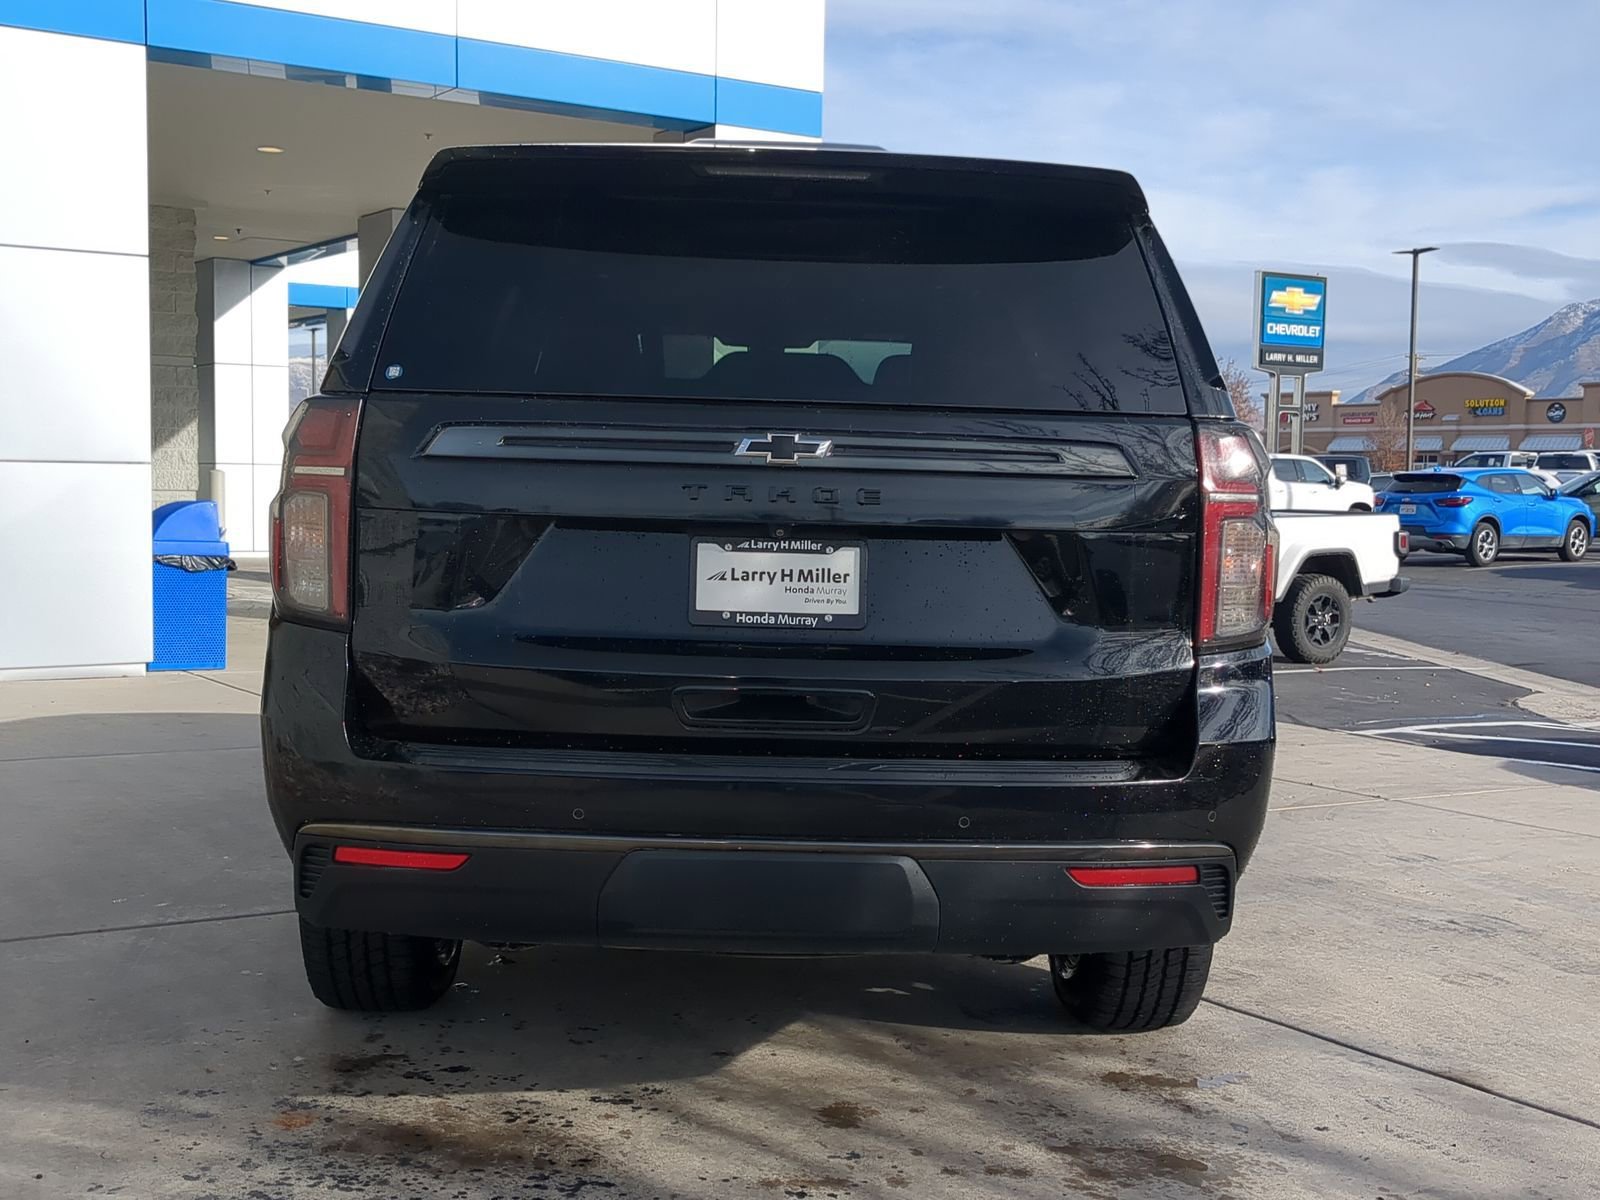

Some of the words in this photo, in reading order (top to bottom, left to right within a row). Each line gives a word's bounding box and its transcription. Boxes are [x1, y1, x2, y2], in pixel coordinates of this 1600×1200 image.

[1266, 322, 1321, 337] CHEVROLET
[1265, 352, 1286, 362] LARRY
[1295, 354, 1318, 364] MILLER
[1464, 399, 1505, 408] SOLUTION
[1476, 407, 1503, 416] LOANS
[681, 484, 881, 506] TAHOE
[751, 540, 778, 551] Larry
[780, 541, 789, 550] H
[791, 541, 822, 551] Miller
[731, 568, 777, 585] Larry
[781, 569, 793, 582] H
[797, 568, 850, 584] Miller
[785, 586, 814, 594] Honda
[816, 587, 847, 596] Murray
[827, 598, 834, 606] By
[736, 613, 775, 624] Honda
[777, 615, 818, 627] Murray
